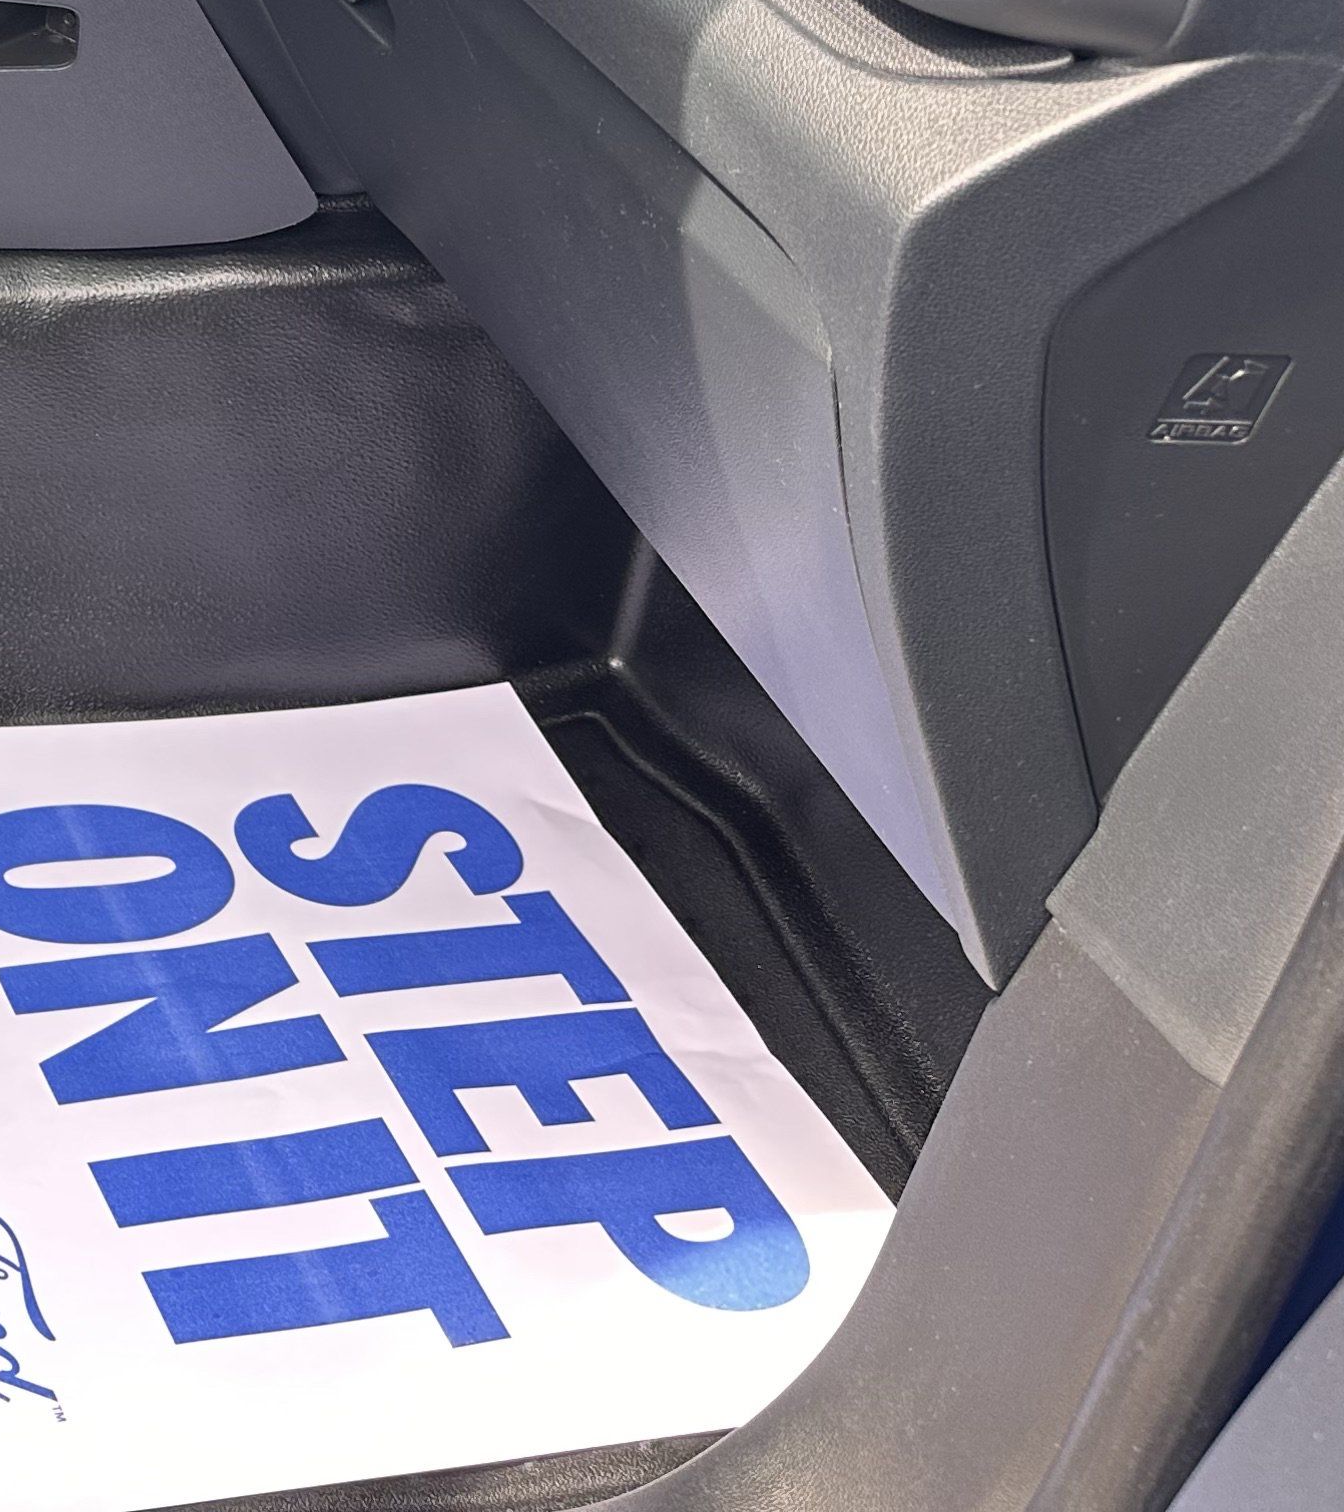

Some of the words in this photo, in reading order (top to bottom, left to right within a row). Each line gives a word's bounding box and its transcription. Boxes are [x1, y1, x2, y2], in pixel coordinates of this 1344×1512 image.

[1150, 423, 1250, 438] AIRBAG
[233, 783, 810, 1310] STEP
[89, 1118, 509, 1347] IT
